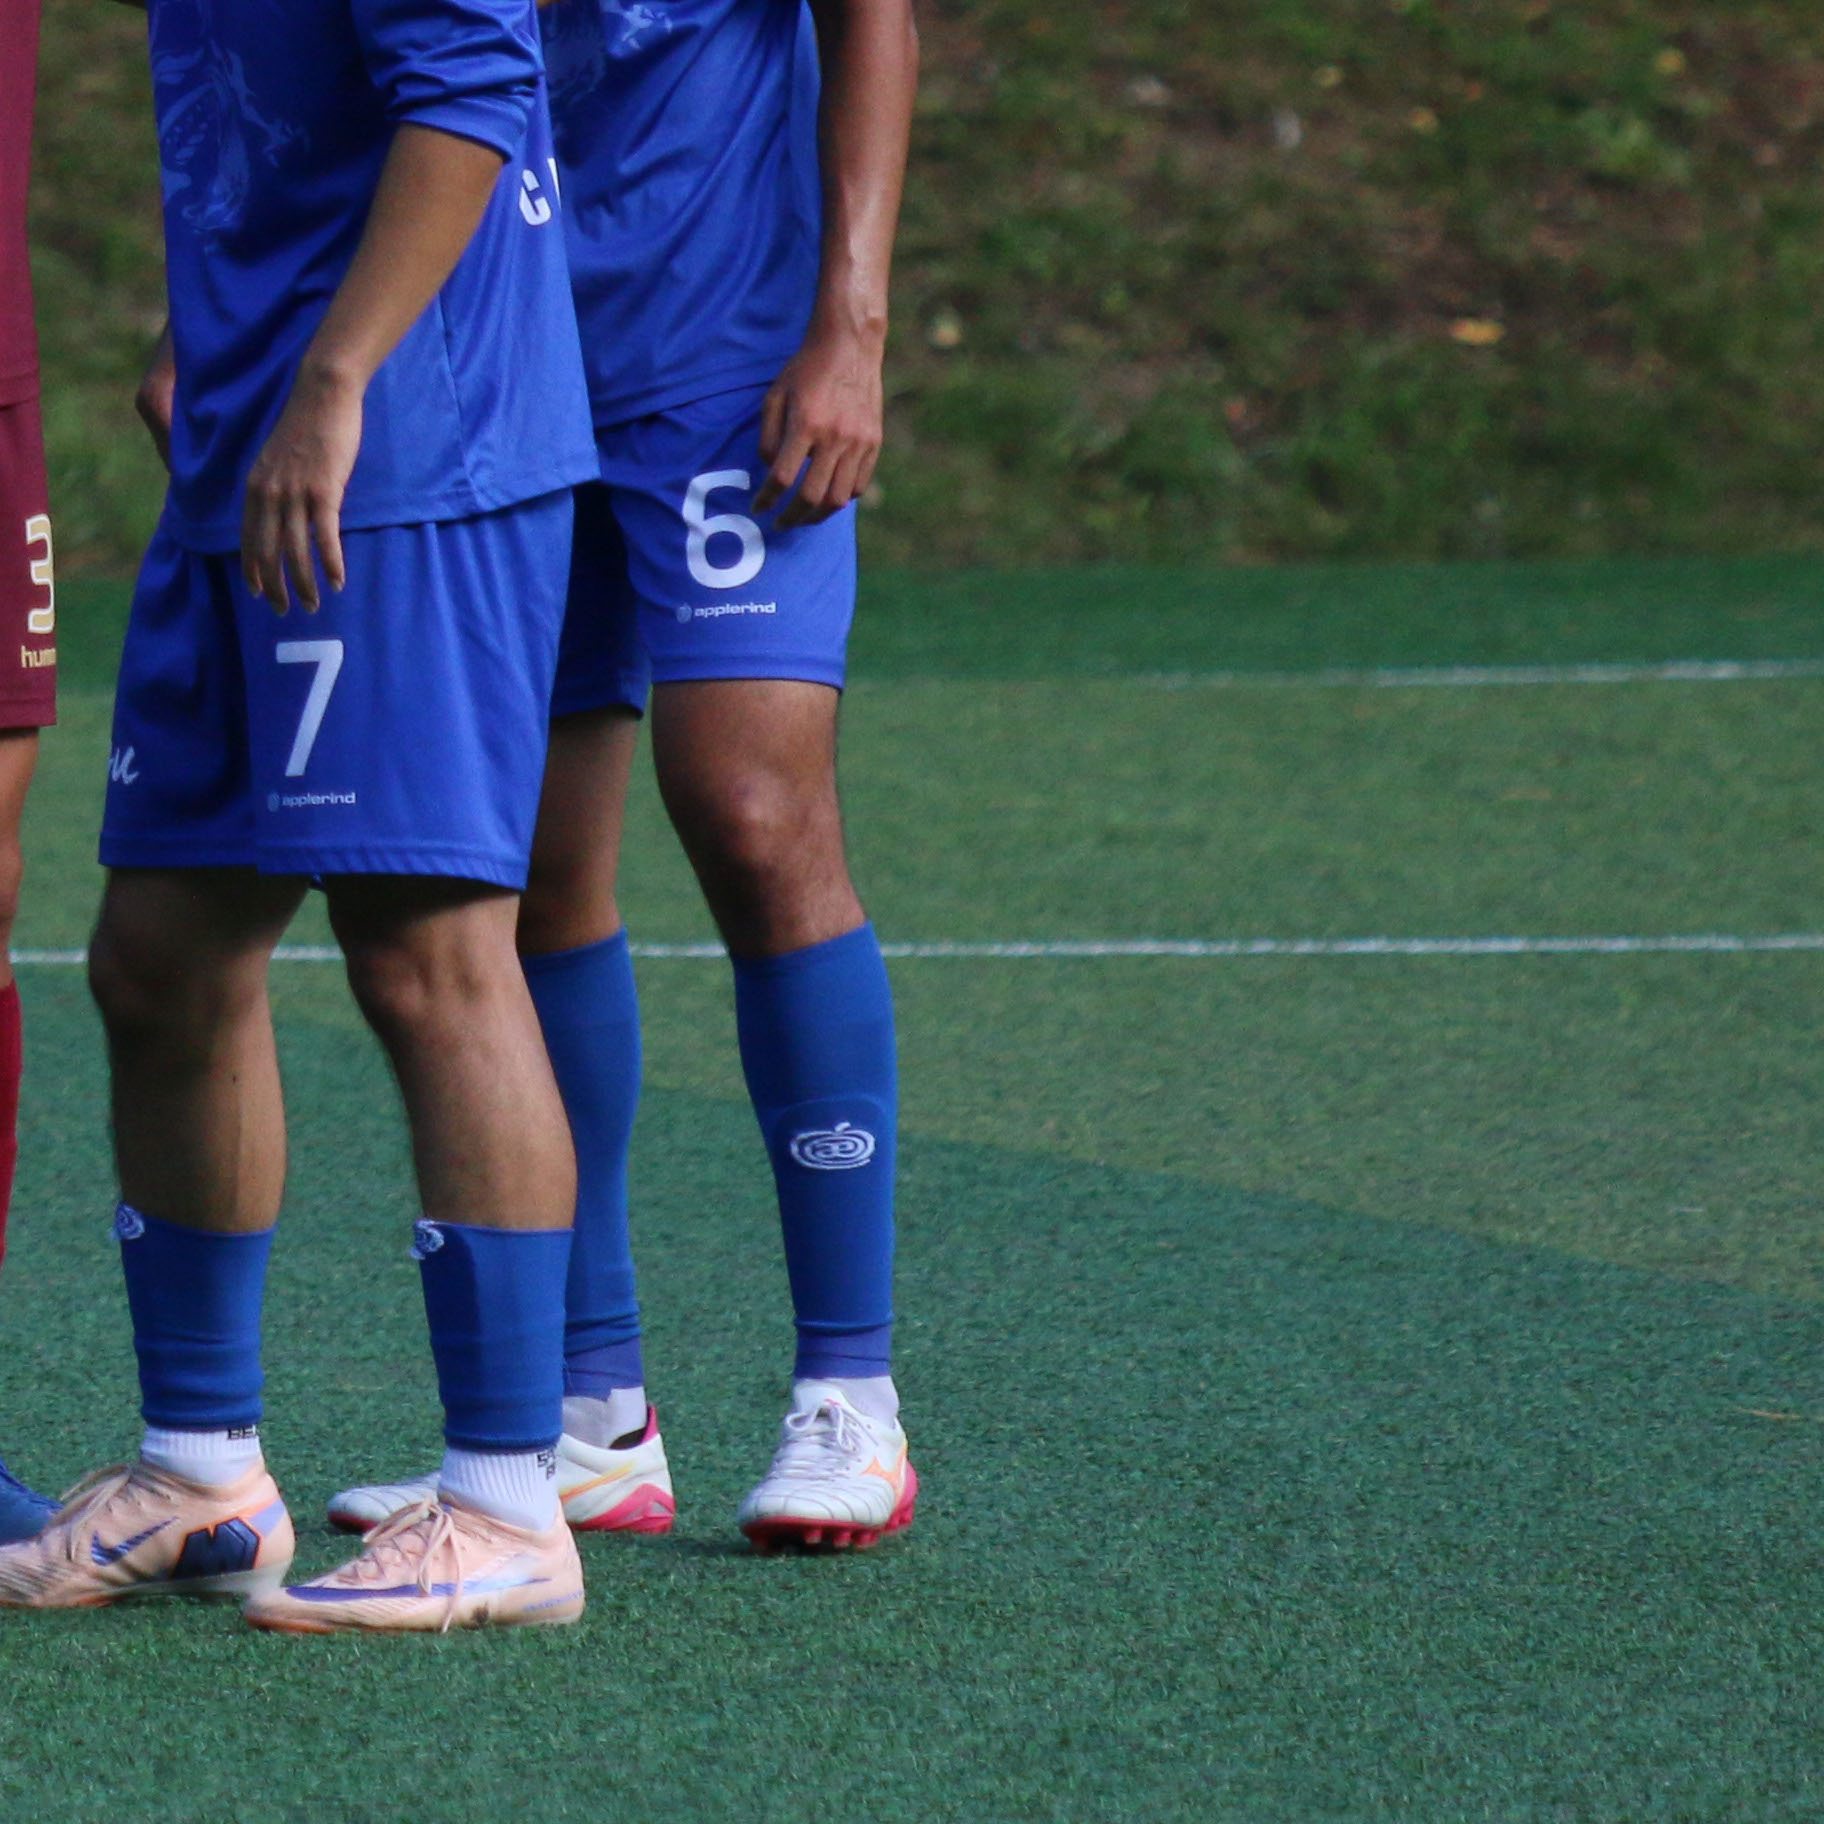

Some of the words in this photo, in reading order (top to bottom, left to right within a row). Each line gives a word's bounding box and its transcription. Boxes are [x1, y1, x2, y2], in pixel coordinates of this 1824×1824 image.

[25, 514, 56, 634] 3
[681, 469, 766, 589] 6
[275, 639, 345, 776] 7
